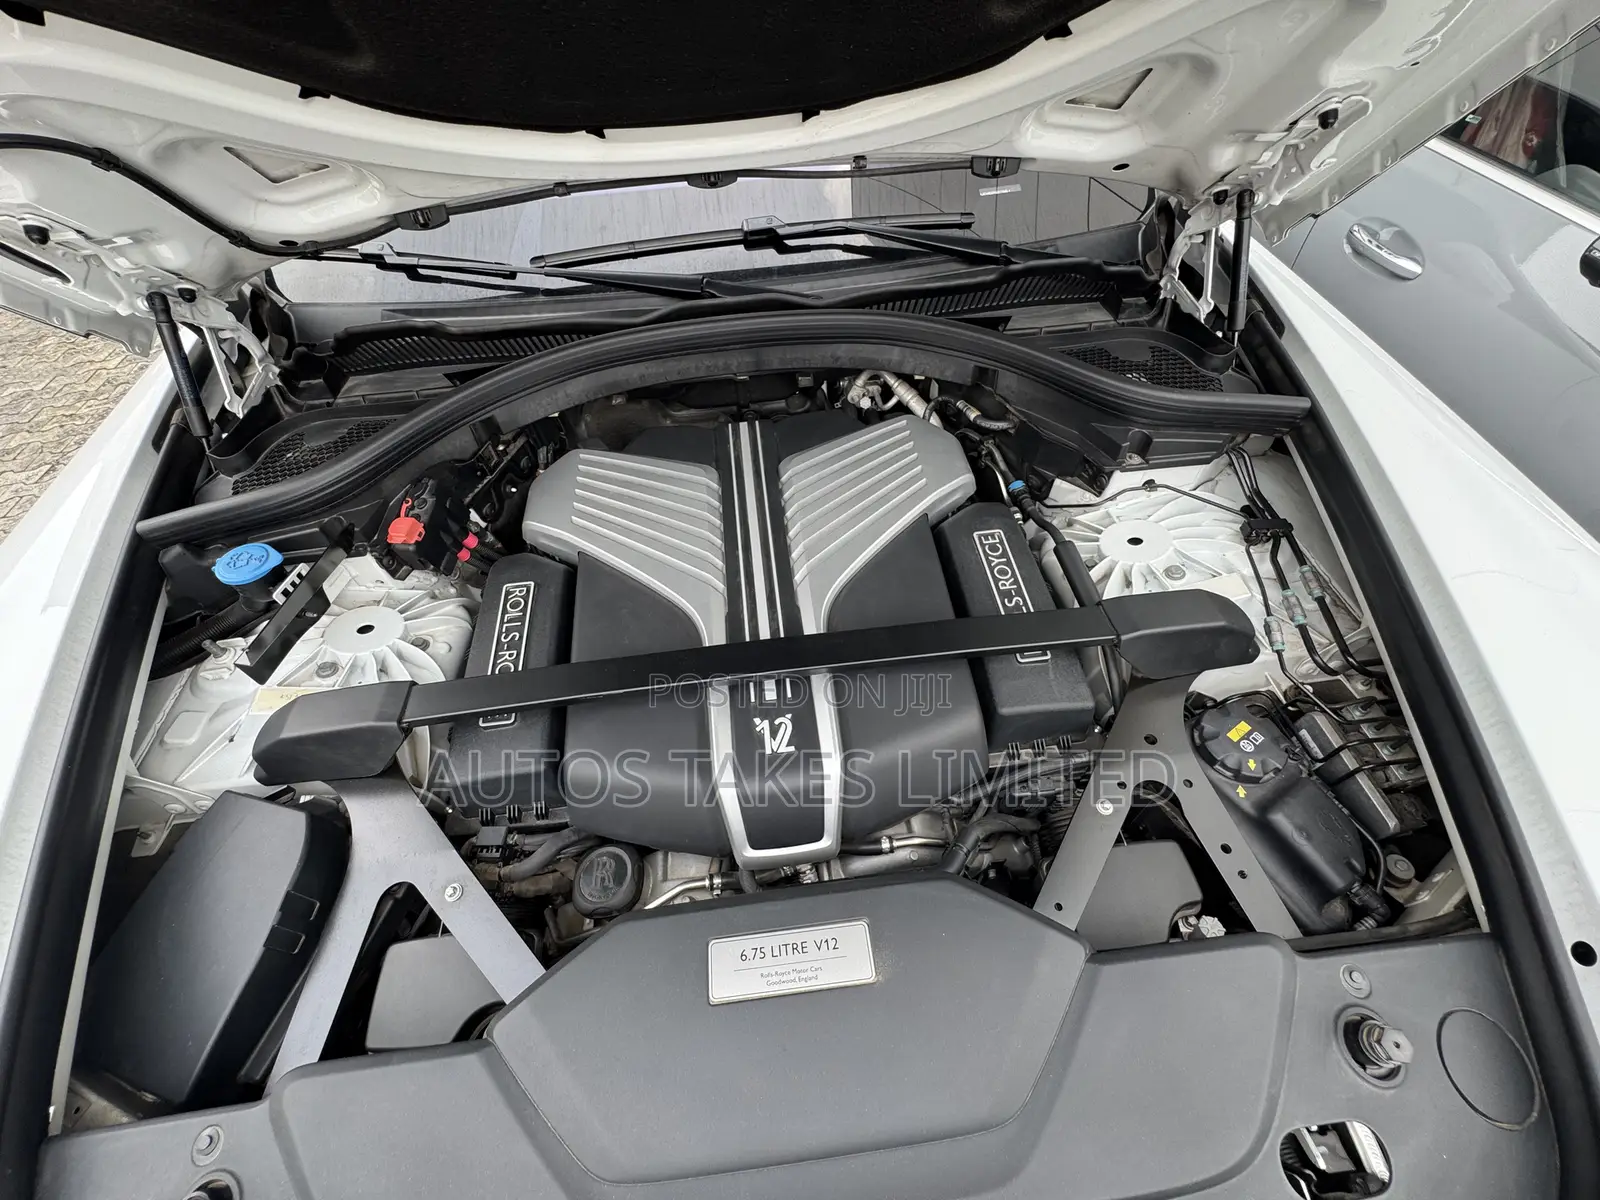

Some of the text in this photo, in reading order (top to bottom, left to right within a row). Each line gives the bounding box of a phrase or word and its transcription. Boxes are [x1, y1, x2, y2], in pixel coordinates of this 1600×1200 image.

[740, 937, 840, 962] 6.75 LITRE V12
[760, 965, 823, 979] Rolls-Royce Motor Cars
[798, 974, 819, 984] England
